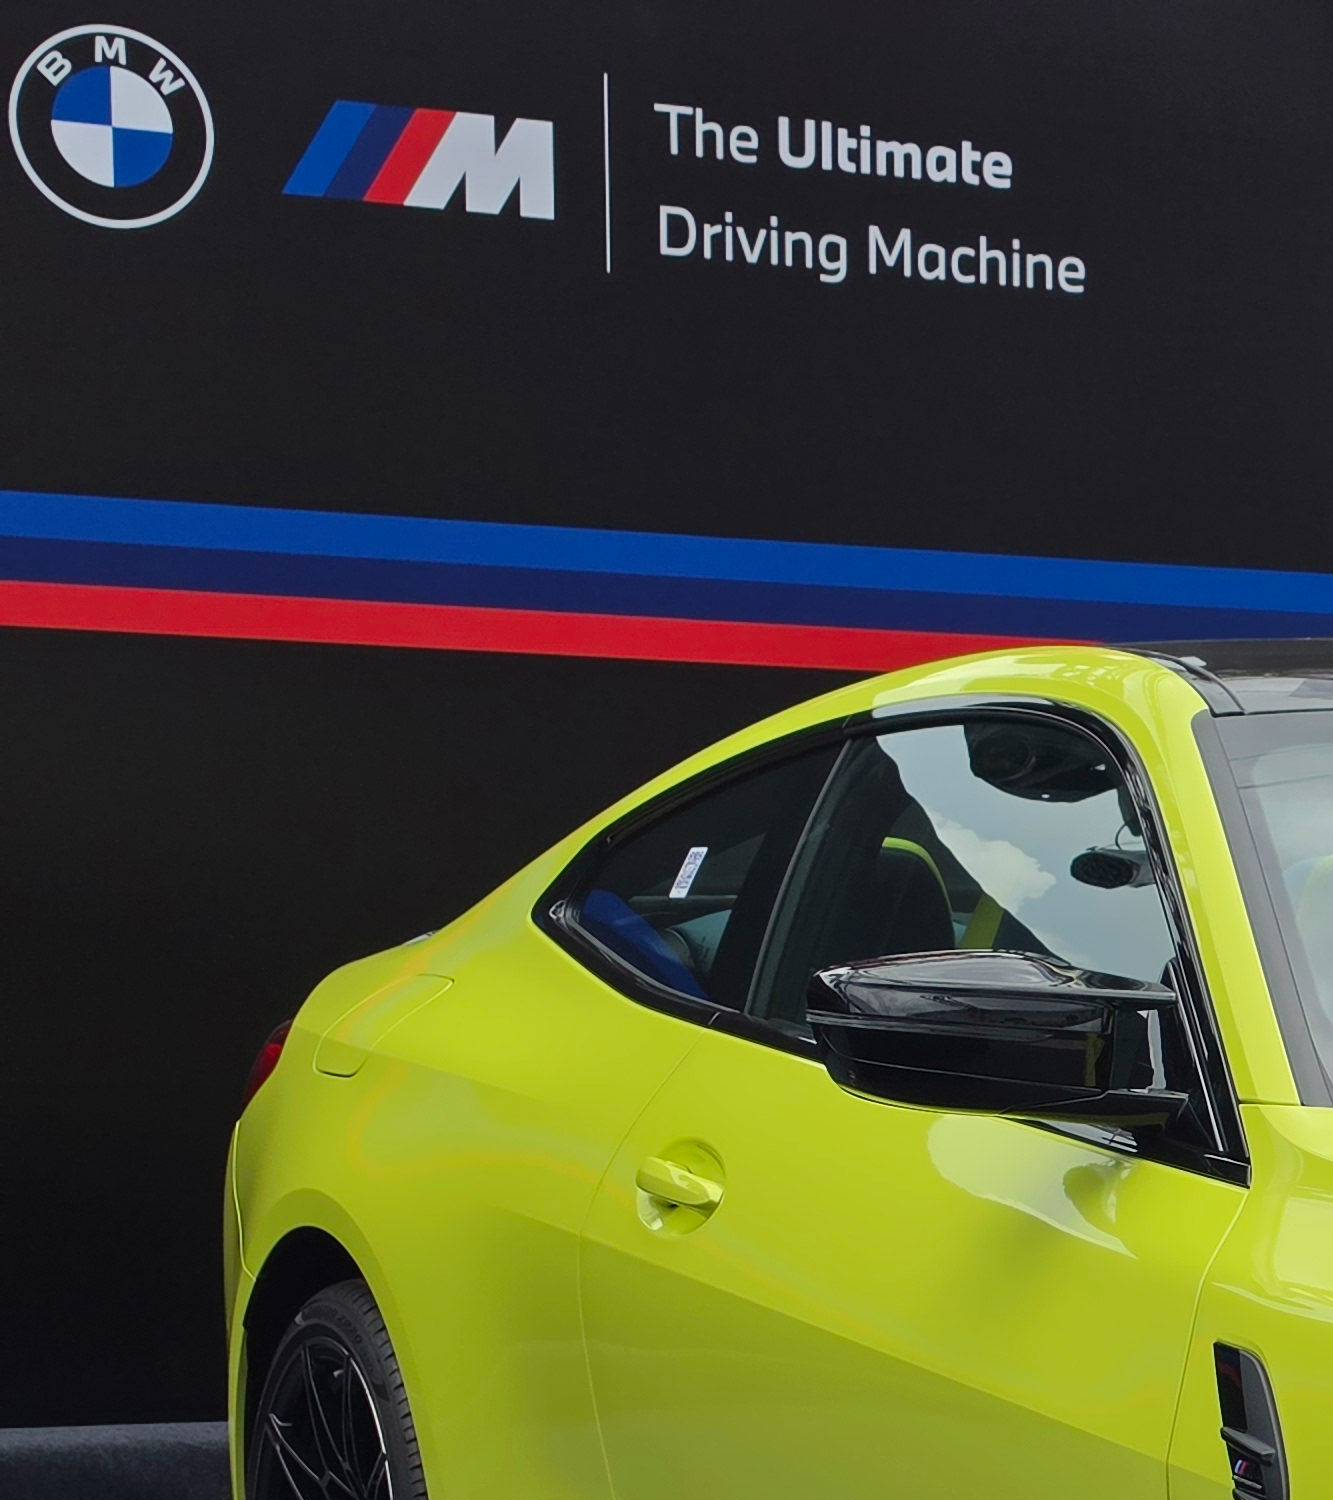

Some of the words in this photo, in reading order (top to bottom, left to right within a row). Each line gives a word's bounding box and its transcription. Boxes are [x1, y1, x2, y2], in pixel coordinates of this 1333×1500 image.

[37, 35, 185, 95] BMW
[653, 102, 759, 164] The
[777, 115, 1013, 189] Ultimate
[659, 204, 848, 284] Driving
[868, 223, 1086, 294] Machine
